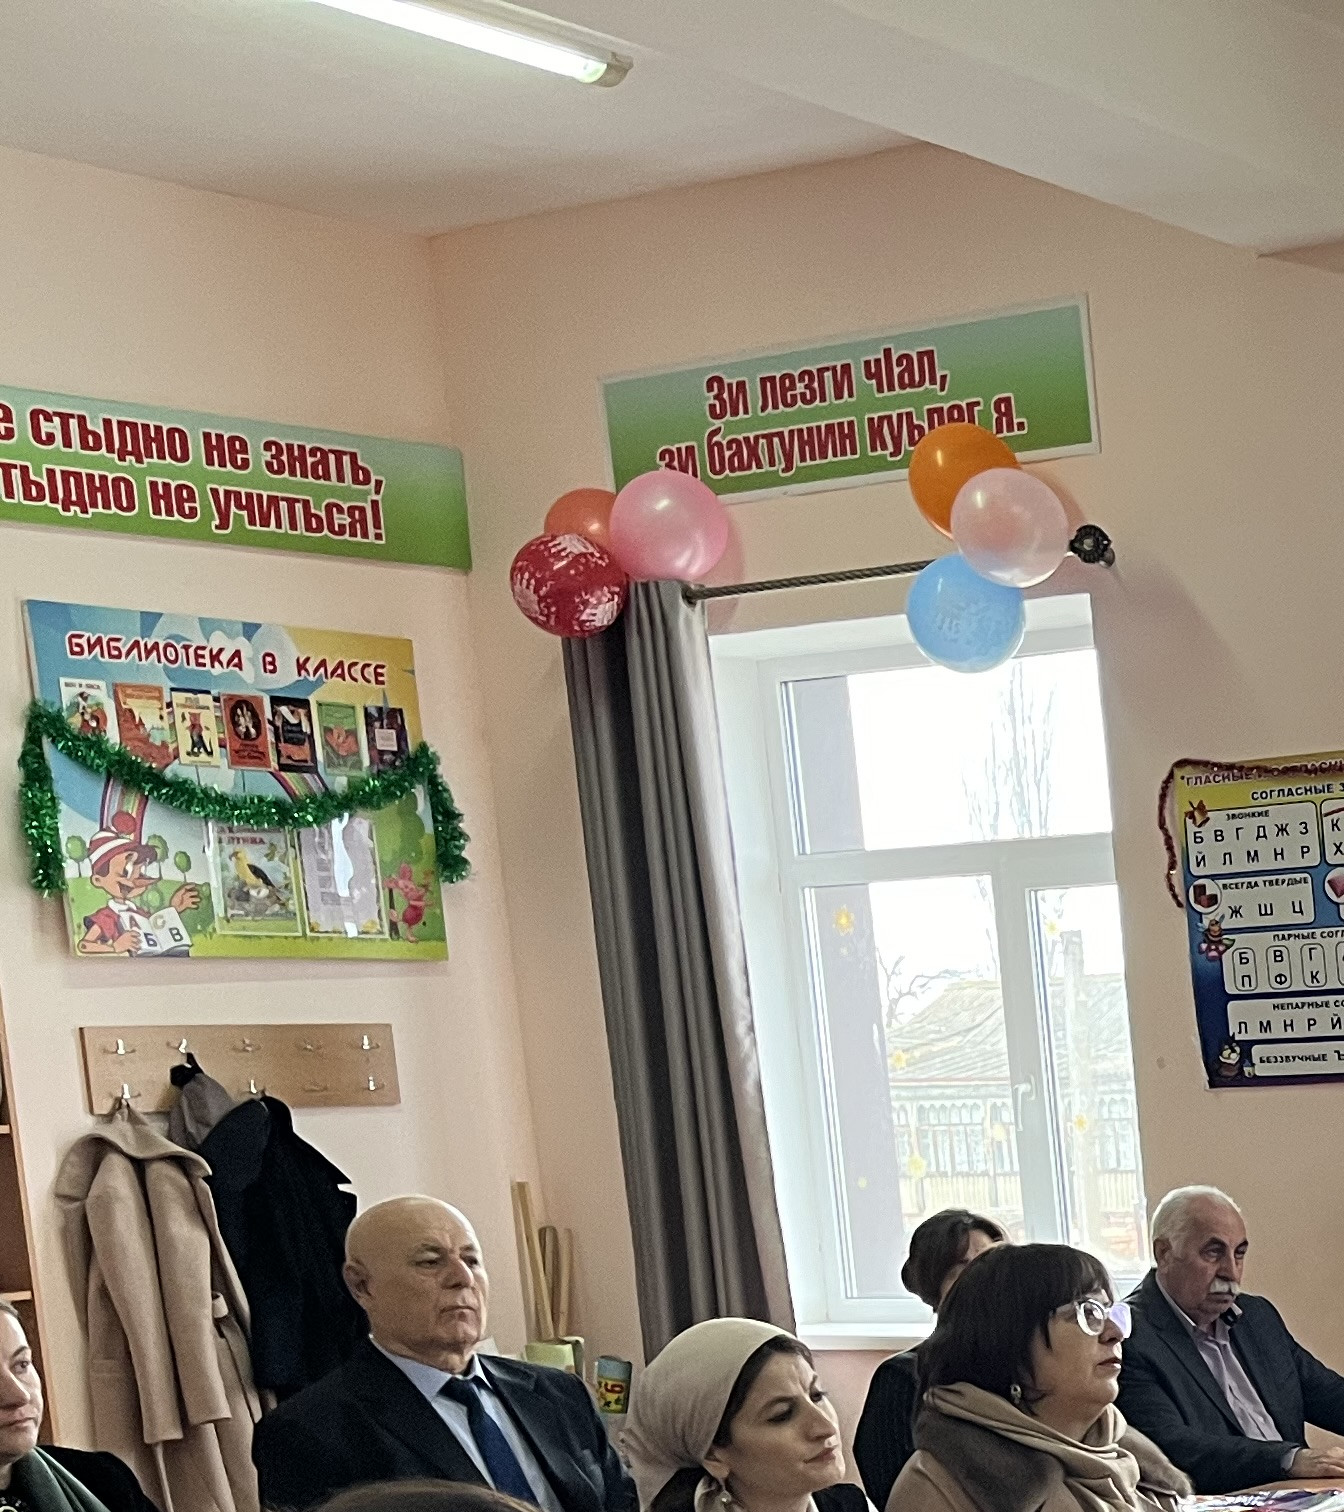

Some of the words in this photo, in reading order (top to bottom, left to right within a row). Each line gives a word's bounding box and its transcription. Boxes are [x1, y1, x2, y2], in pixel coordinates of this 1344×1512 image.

[706, 376, 749, 420] Зи
[760, 363, 853, 413] лезги
[706, 418, 858, 476] бахтунин
[993, 396, 1025, 432] я.
[30, 408, 190, 465] стыдно
[202, 431, 250, 471] не
[263, 440, 383, 495] знать,
[150, 480, 198, 520] не
[208, 487, 383, 541] учиться!
[67, 633, 244, 671] БИБЛИОТЕКА
[262, 652, 277, 675] В
[296, 656, 386, 685] КЛАССЕ
[1251, 785, 1334, 801] СОГЛАСНЫЕ
[1194, 831, 1204, 844] Б
[1214, 830, 1224, 842] В
[1236, 827, 1243, 840] Г
[1256, 826, 1267, 841] Д
[1275, 823, 1289, 837] Ж
[1299, 822, 1308, 835] З
[1331, 818, 1341, 831] К
[1196, 852, 1206, 867] Й
[1223, 852, 1232, 865] Л
[1247, 850, 1259, 863] М
[1274, 848, 1284, 861] Н
[1301, 846, 1310, 859] Р
[1333, 842, 1344, 855] Х
[1222, 880, 1259, 890] ВСЕГДА
[1228, 906, 1242, 919] Ж
[1258, 903, 1273, 916] Ш
[1292, 900, 1303, 915] Ц
[144, 932, 157, 947] Б
[170, 928, 183, 942] В
[1272, 931, 1317, 942] ПАРНЫЕ
[1239, 952, 1249, 965] Б
[1274, 950, 1283, 962] В
[1309, 948, 1317, 961] Г
[1242, 975, 1252, 987] П
[1275, 973, 1287, 985] Ф
[1311, 971, 1320, 984] К
[1272, 1001, 1330, 1011] НЕПАРНЫЕ
[1238, 1022, 1248, 1034] Л
[1259, 1020, 1271, 1033] М
[1284, 1019, 1294, 1032] Н
[1308, 1018, 1316, 1031] Р
[1331, 1013, 1341, 1030] Й
